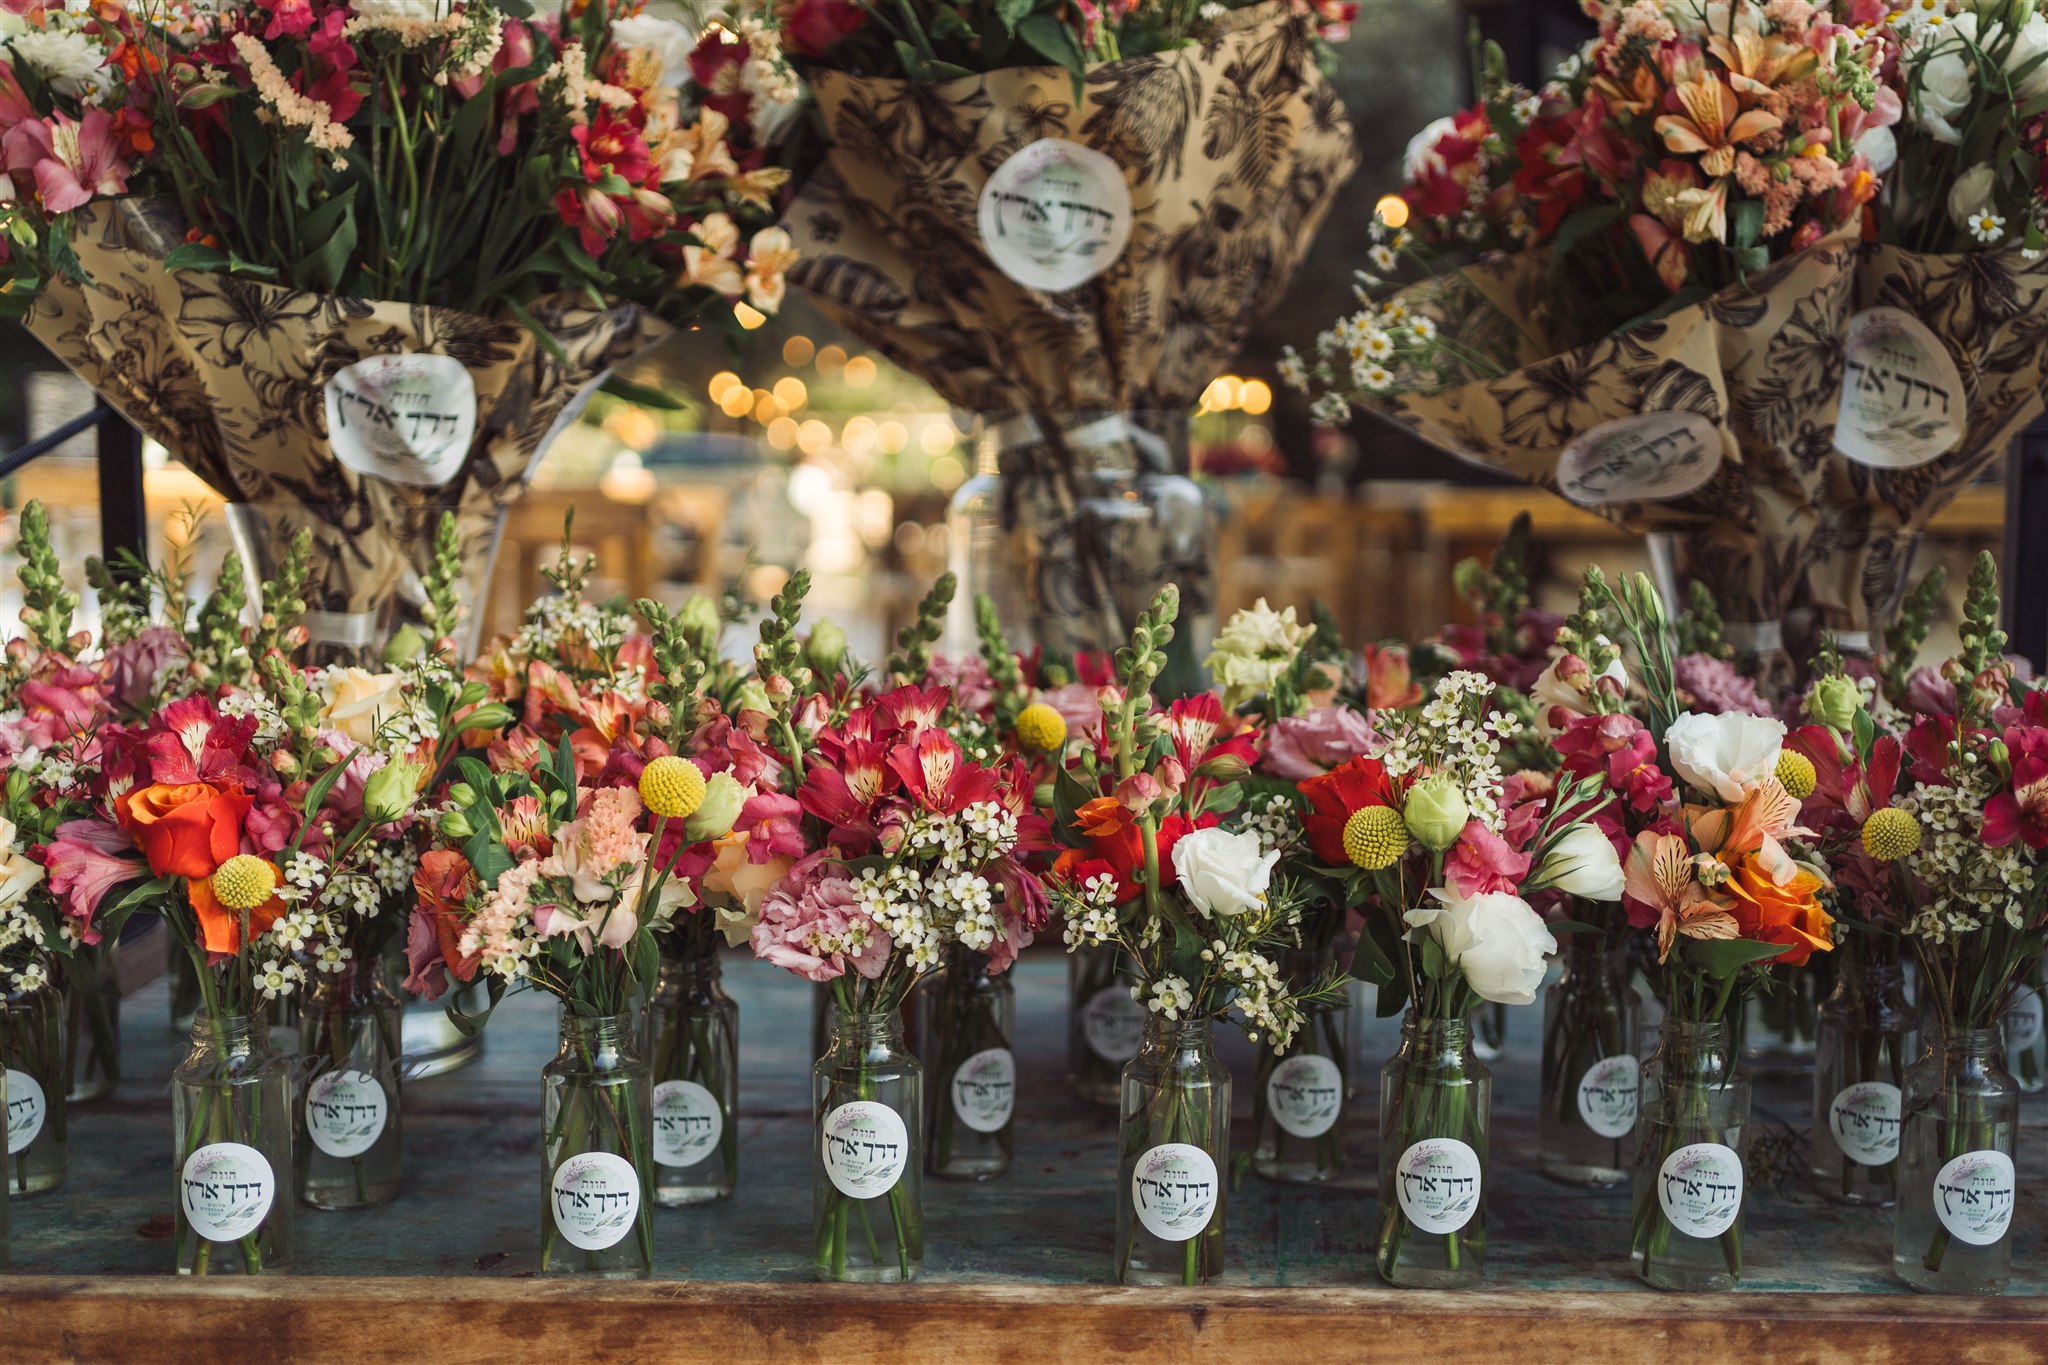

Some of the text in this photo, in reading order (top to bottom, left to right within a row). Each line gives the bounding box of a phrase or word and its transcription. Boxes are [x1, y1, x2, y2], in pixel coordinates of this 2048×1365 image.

[1848, 360, 1889, 394] אר
[332, 383, 399, 429] ארץ
[1895, 372, 1948, 414] דרך
[406, 411, 459, 441] דרך
[308, 1099, 341, 1129] ארץ
[343, 1104, 377, 1124] דרך
[654, 1116, 711, 1134] דרך אר
[851, 1128, 876, 1139] חוות
[825, 1132, 898, 1166] דרך ארץ
[209, 1171, 236, 1180] חוות
[1163, 1169, 1188, 1179] חוות
[1428, 1164, 1453, 1174] חוות
[1694, 1169, 1720, 1180] חוות
[1971, 1177, 1996, 1186] חוות
[184, 1178, 262, 1212] דרך ארץ
[581, 1180, 607, 1189] חוות
[1136, 1175, 1210, 1209] דרך ארץ
[1400, 1170, 1473, 1204] דרך ארץ
[1663, 1171, 1736, 1205] דרך ארץ
[1939, 1182, 2011, 1216] דרך ארץ
[554, 1186, 630, 1220] דרך ארץ
